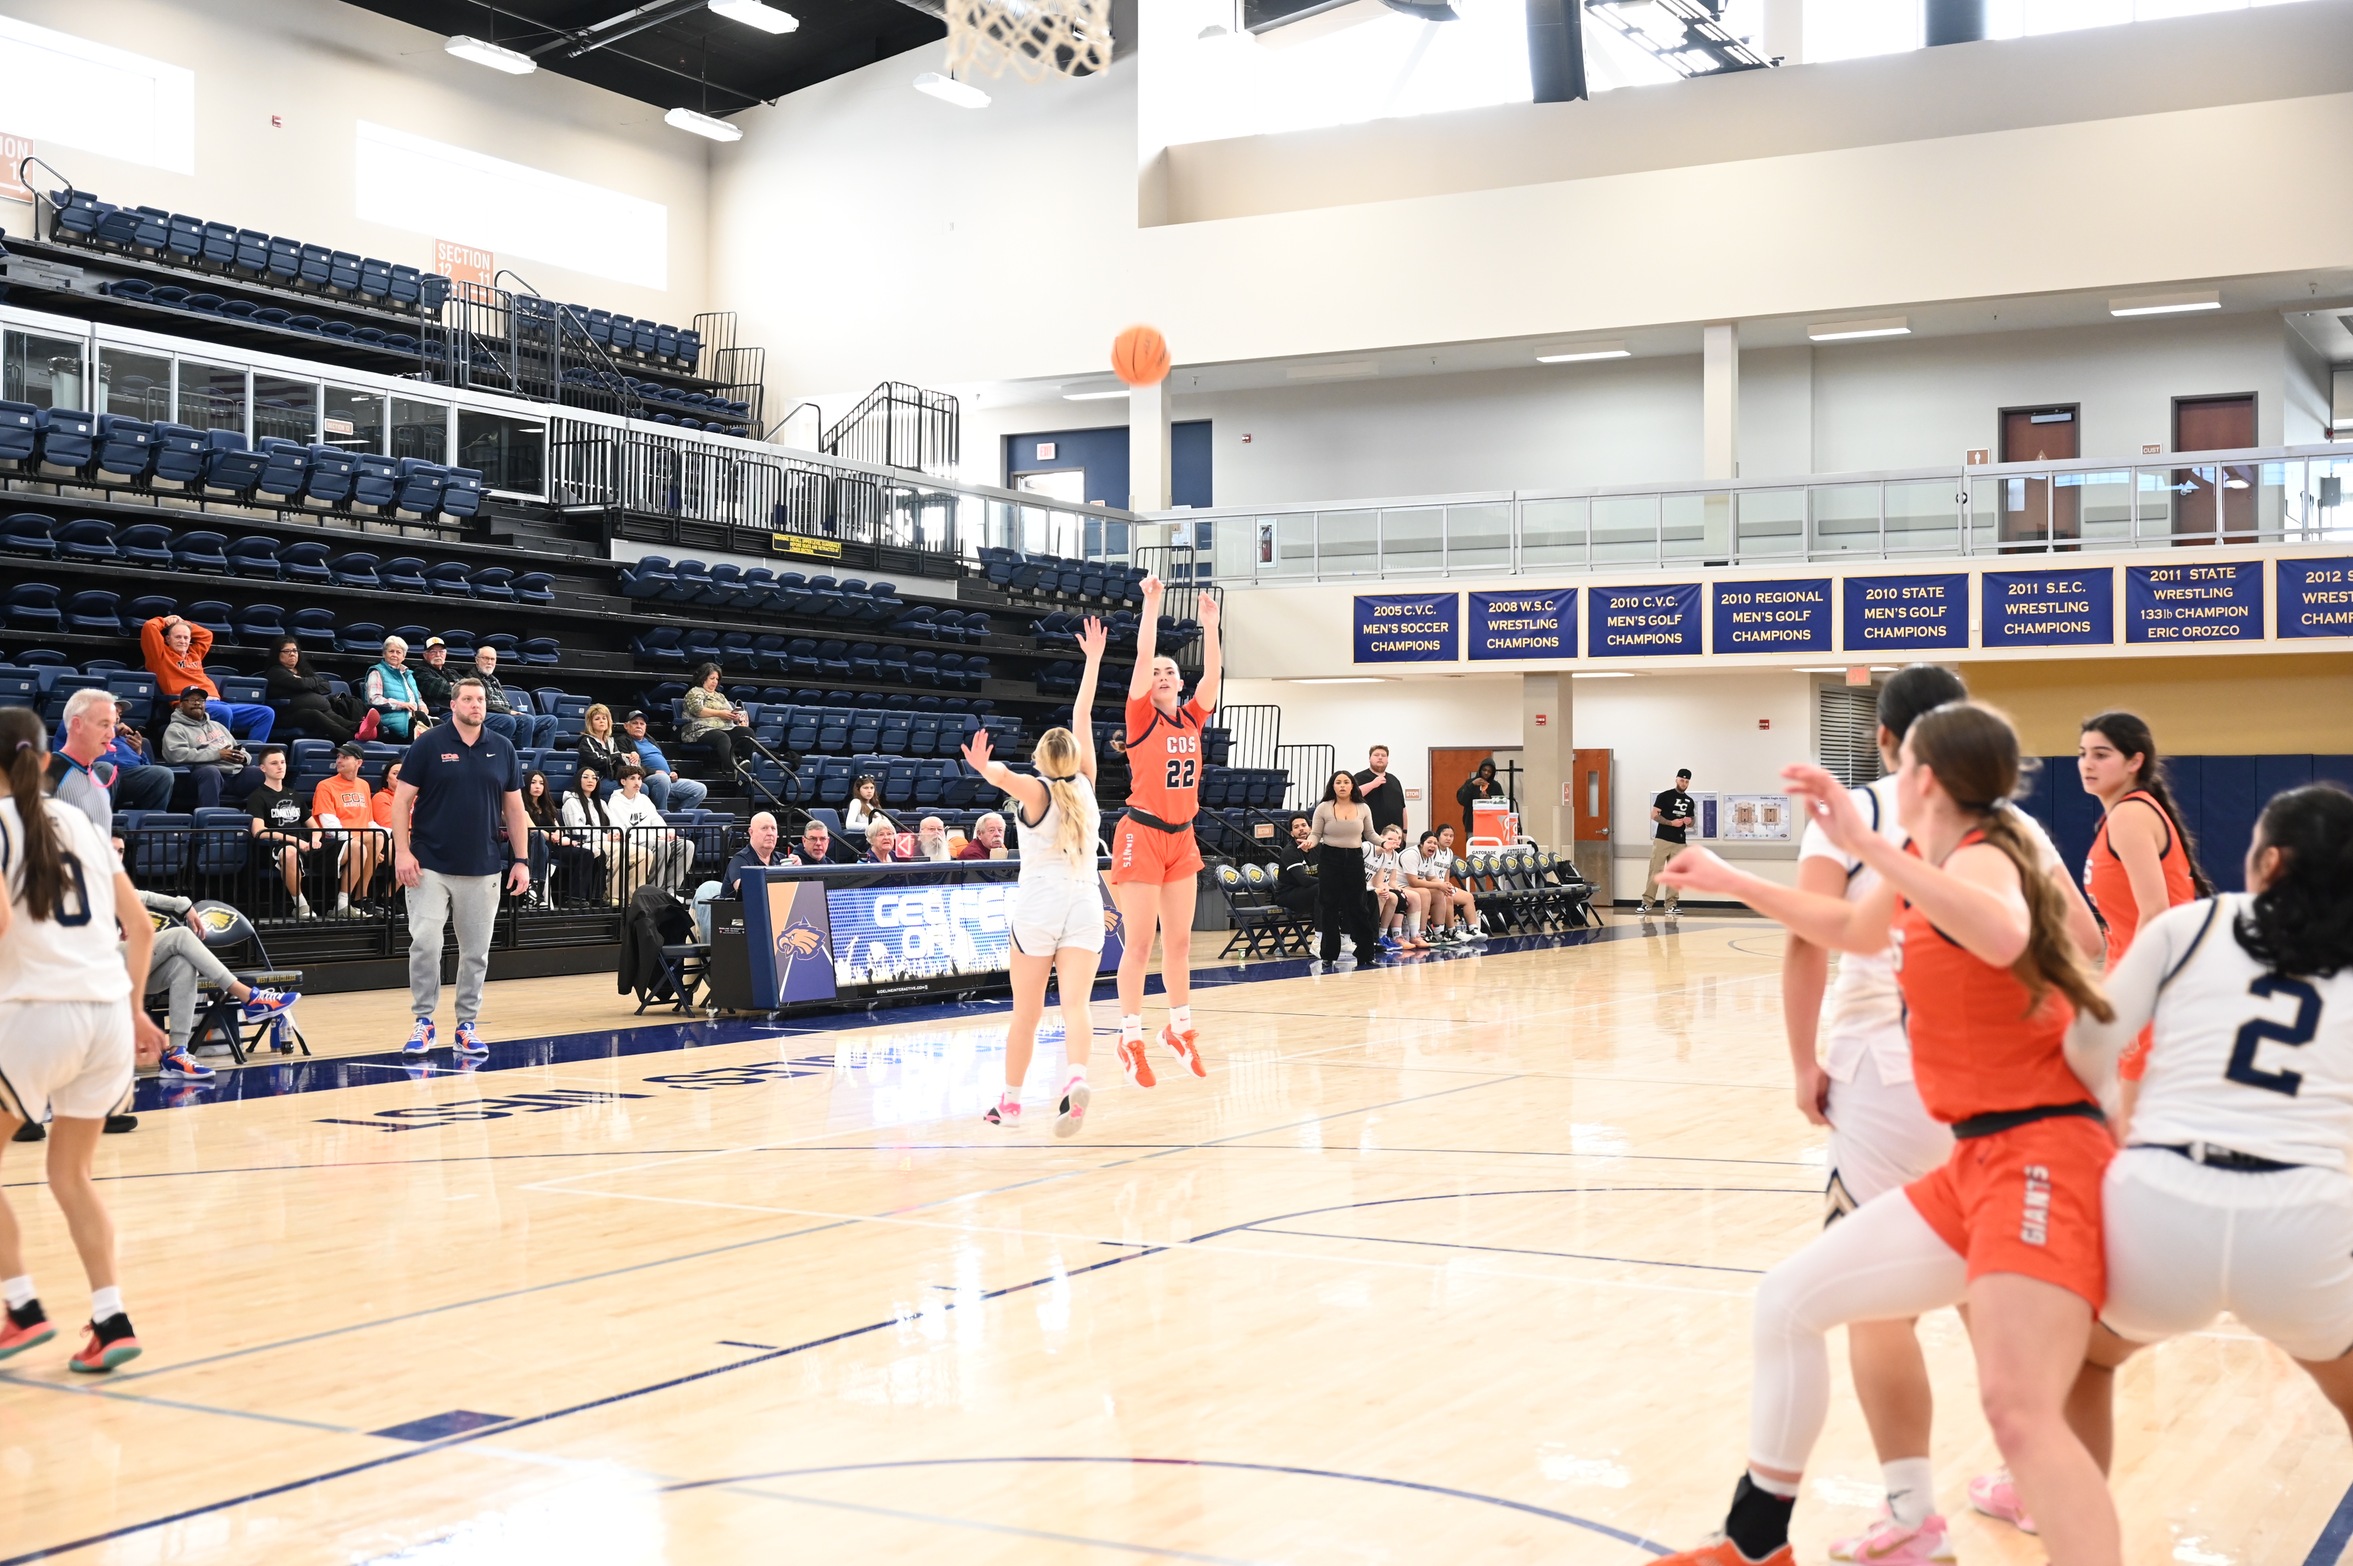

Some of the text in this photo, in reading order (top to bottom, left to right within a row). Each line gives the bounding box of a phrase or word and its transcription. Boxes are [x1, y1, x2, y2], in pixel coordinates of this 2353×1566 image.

[438, 242, 490, 270] SECTION
[2149, 567, 2237, 582] 2011 STATE
[2305, 570, 2342, 584] 2012
[1865, 586, 1945, 600] 2010 STATE
[2008, 581, 2086, 595] 2011 S.E.C.
[2153, 587, 2234, 600] WRESTLING
[1610, 595, 1679, 609] 2010 C.V.C.
[1720, 591, 1824, 605] 2010 REGIONAL
[1373, 604, 1437, 617] 2005 C.V.C.
[1488, 600, 1557, 613] 2008 W.S.C.
[1909, 606, 1947, 618] GOLF
[2005, 601, 2090, 615] WRESTLING
[2174, 605, 2249, 619] CHAMPION
[1647, 614, 1683, 626] GOLF
[1775, 610, 1812, 622] GOLF
[1400, 622, 1449, 634] SOCCER
[1487, 618, 1558, 631] WRESTLING
[2004, 621, 2091, 635] CHAMPIONS
[2147, 624, 2241, 639] ERIC OROZCO
[1607, 633, 1684, 646] CHAMPIONS
[1732, 629, 1812, 643] CHAMPIONS
[1864, 626, 1948, 639] CHAMPIONS
[1370, 640, 1441, 652] CHAMPIONS
[1486, 636, 1560, 649] CHAMPIONS
[1166, 735, 1197, 754] COS
[1165, 758, 1196, 789] 22
[1123, 833, 1134, 868] GIANTS
[2225, 972, 2324, 1098] 2
[2021, 1165, 2050, 1246] GIANTS
